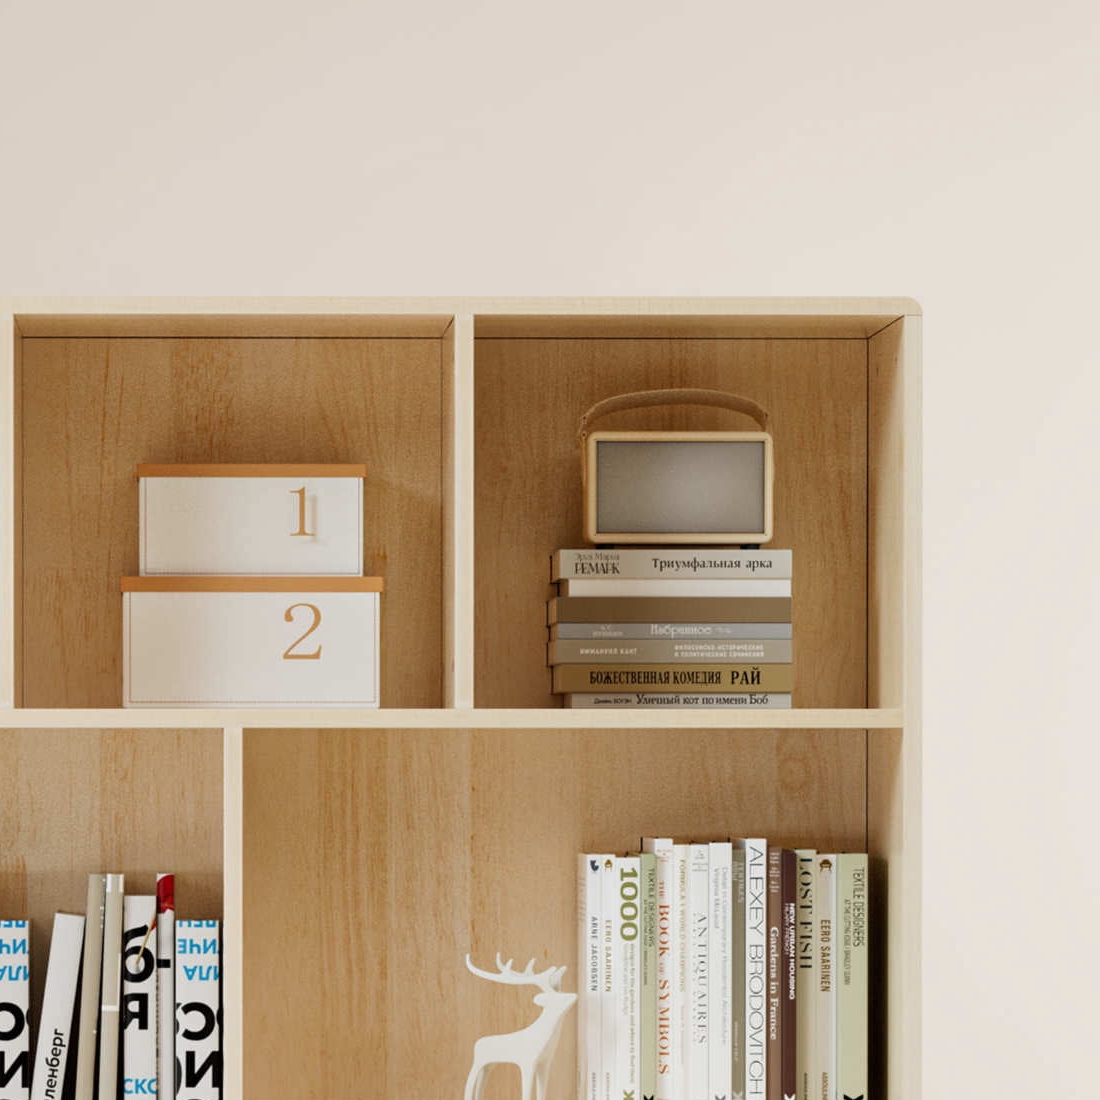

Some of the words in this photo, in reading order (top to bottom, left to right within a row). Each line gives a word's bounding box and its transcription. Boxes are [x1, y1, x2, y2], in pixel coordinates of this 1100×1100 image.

[288, 486, 316, 537] 1
[652, 557, 741, 572] Триумфальная
[745, 560, 773, 572] арка
[282, 602, 322, 660] 2
[589, 670, 670, 685] БОЖЕСТВЕННАЯ
[672, 670, 722, 685] КОМЕДИЯ
[731, 666, 761, 685] РАЙ
[636, 693, 680, 705] Уличный
[682, 696, 699, 705] кот
[715, 696, 747, 705] имени
[748, 693, 769, 705] Боб
[620, 867, 638, 941] 1000
[749, 846, 764, 937] ALEXEY
[799, 857, 813, 915] LOST
[852, 867, 865, 899] TEXTILE
[658, 905, 670, 957] BOOK
[799, 920, 813, 969] FISH
[820, 919, 831, 943] EERO
[852, 901, 865, 947] DESIGNERS
[770, 926, 780, 979] Gardens
[820, 945, 831, 992] SAARINEN
[770, 981, 779, 994] in
[658, 979, 670, 1075] SYMBOLS
[749, 944, 764, 1095] BRODOVITCH
[770, 998, 779, 1041] France
